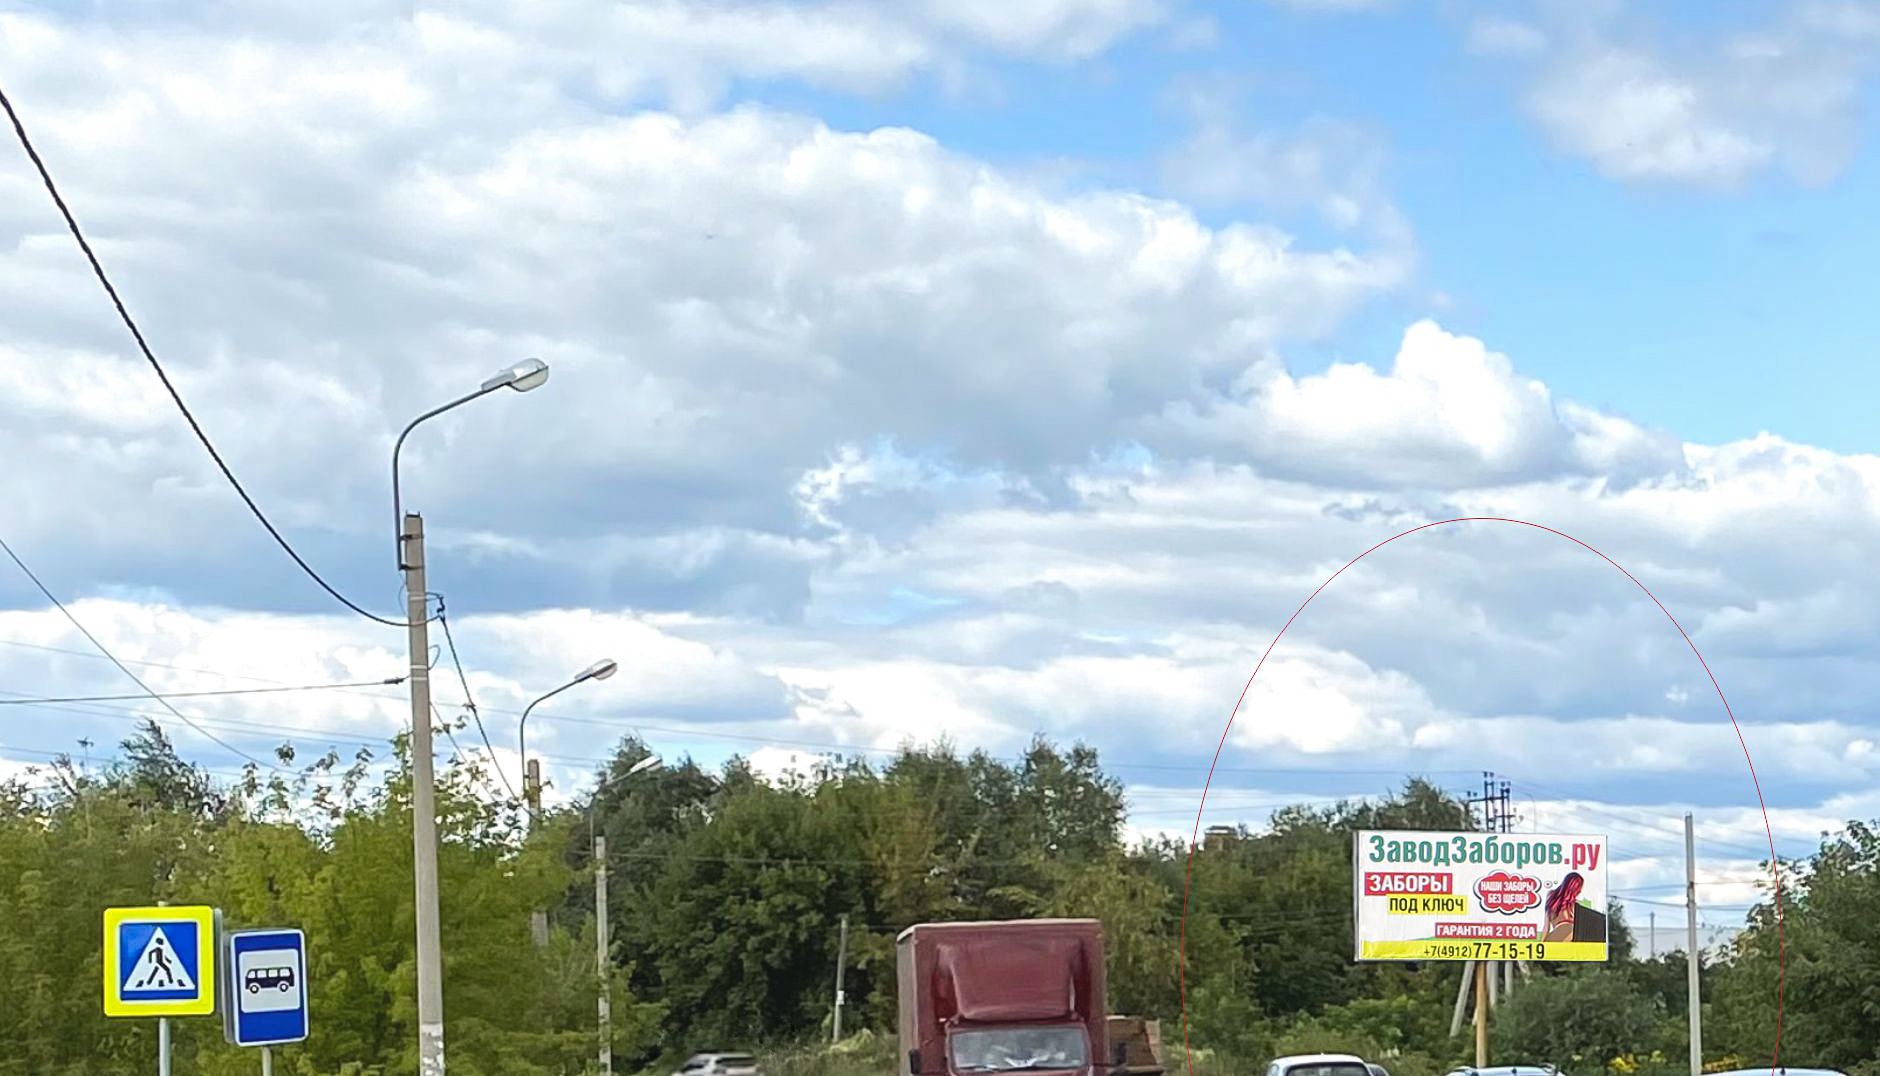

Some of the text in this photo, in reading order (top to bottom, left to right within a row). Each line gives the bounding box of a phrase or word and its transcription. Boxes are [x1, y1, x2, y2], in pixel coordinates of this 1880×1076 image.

[1369, 835, 1600, 871] ЗаводЗаборов.ру
[1369, 874, 1448, 892] ЗАБОРЫ
[1481, 881, 1534, 891] НАШИ ЗАБОРЫ
[1389, 898, 1464, 913] ПОД КЛЮЧ
[1487, 892, 1529, 905] БЕЗ ЩЕЛЕЙ
[1437, 925, 1536, 938] ГАРАНТИЯ 2 ГОДА
